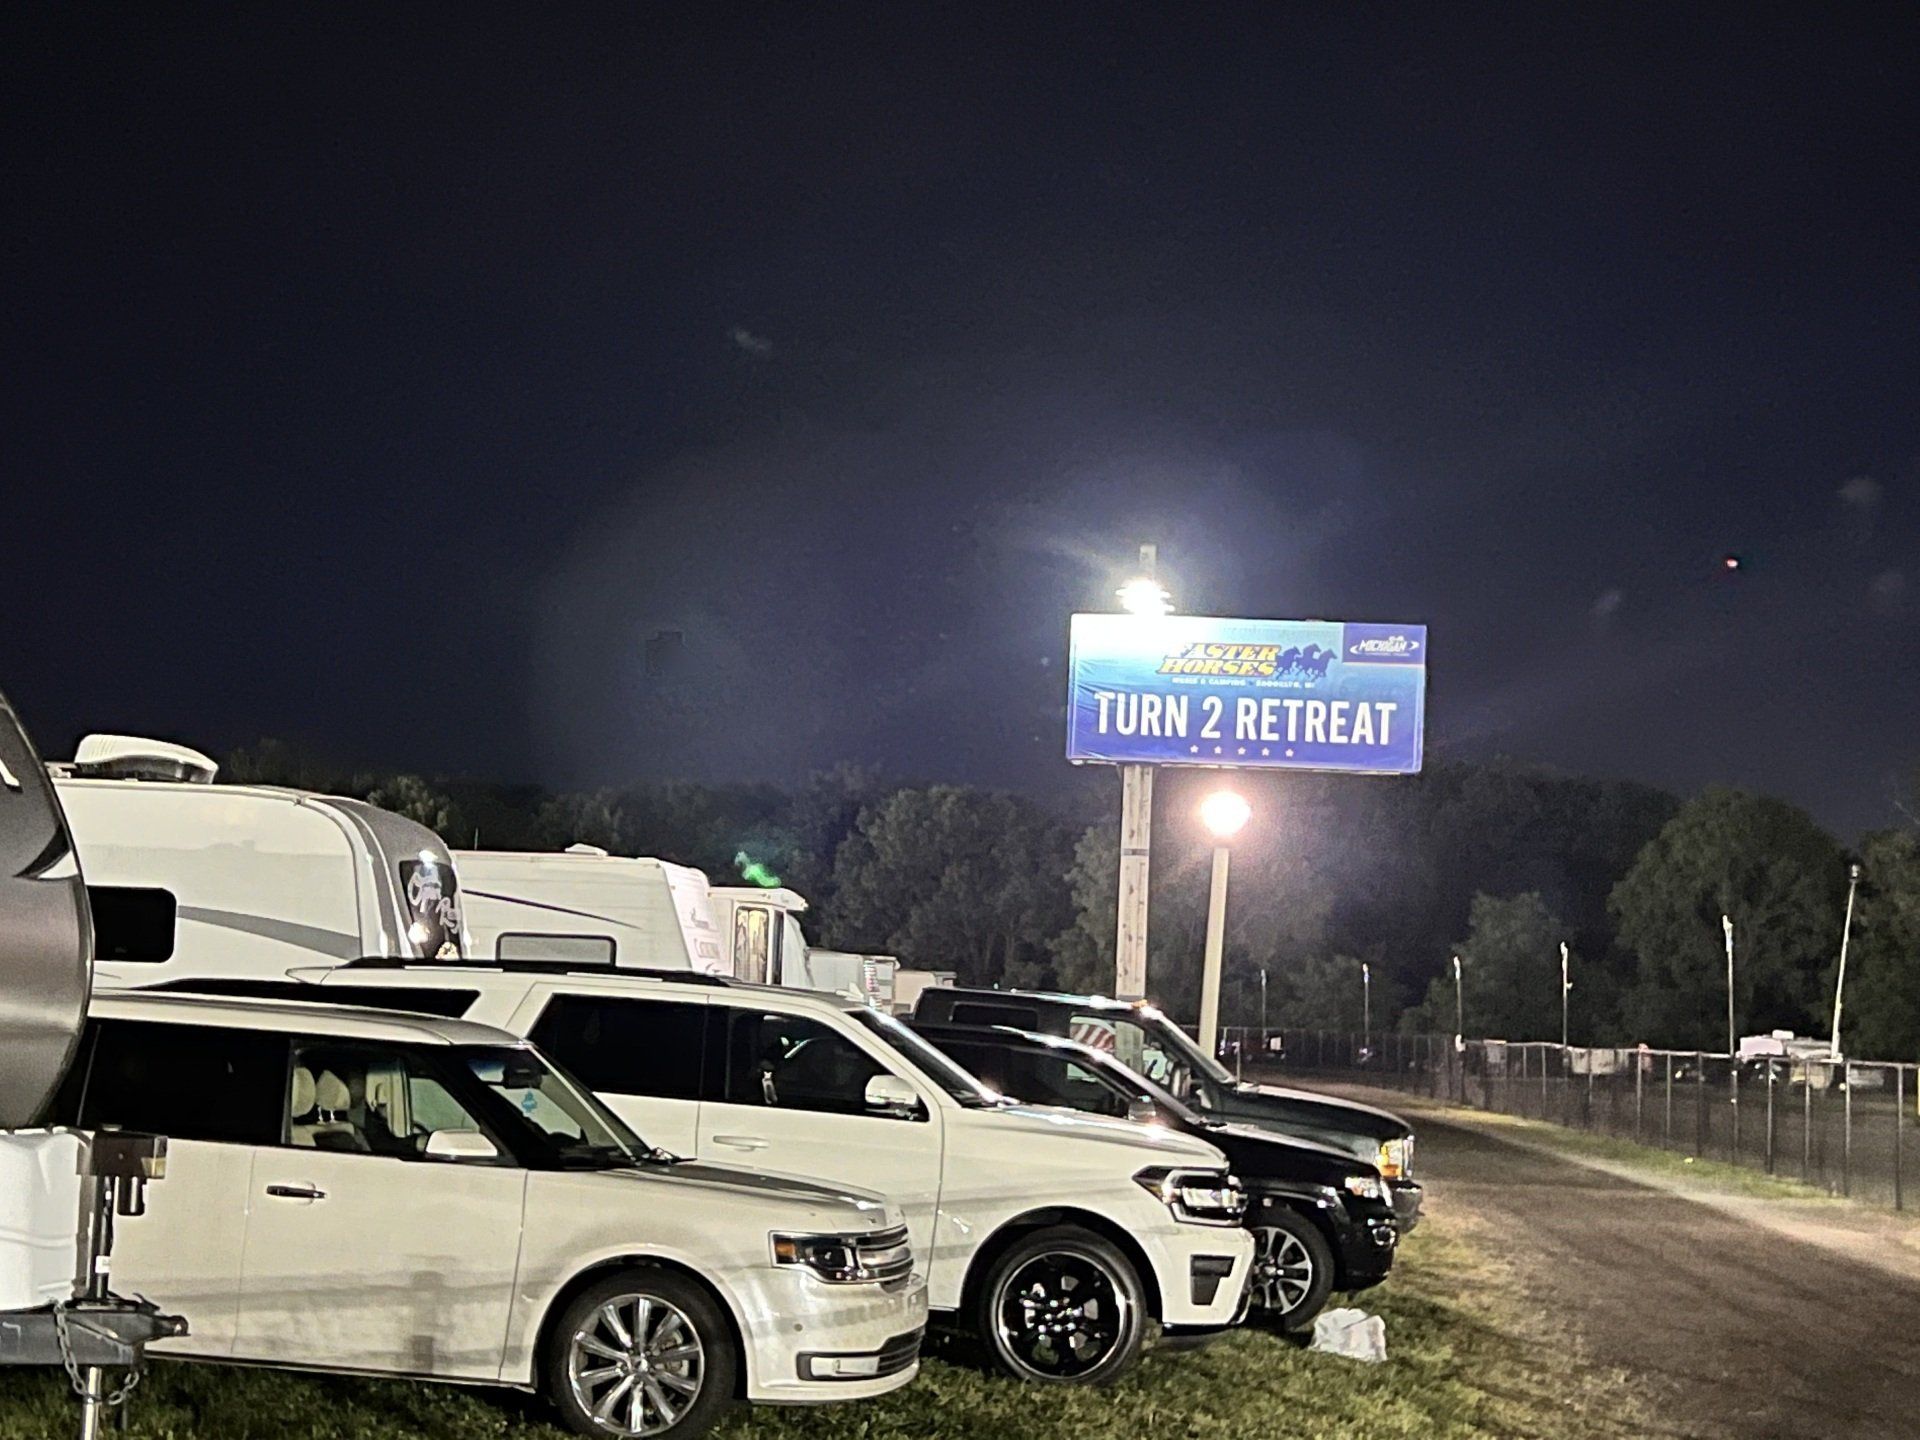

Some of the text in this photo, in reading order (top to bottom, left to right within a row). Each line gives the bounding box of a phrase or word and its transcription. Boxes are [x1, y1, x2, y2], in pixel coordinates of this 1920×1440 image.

[1160, 659, 1277, 675] HORSES
[1094, 692, 1397, 746] TURN 2 RETREAT
